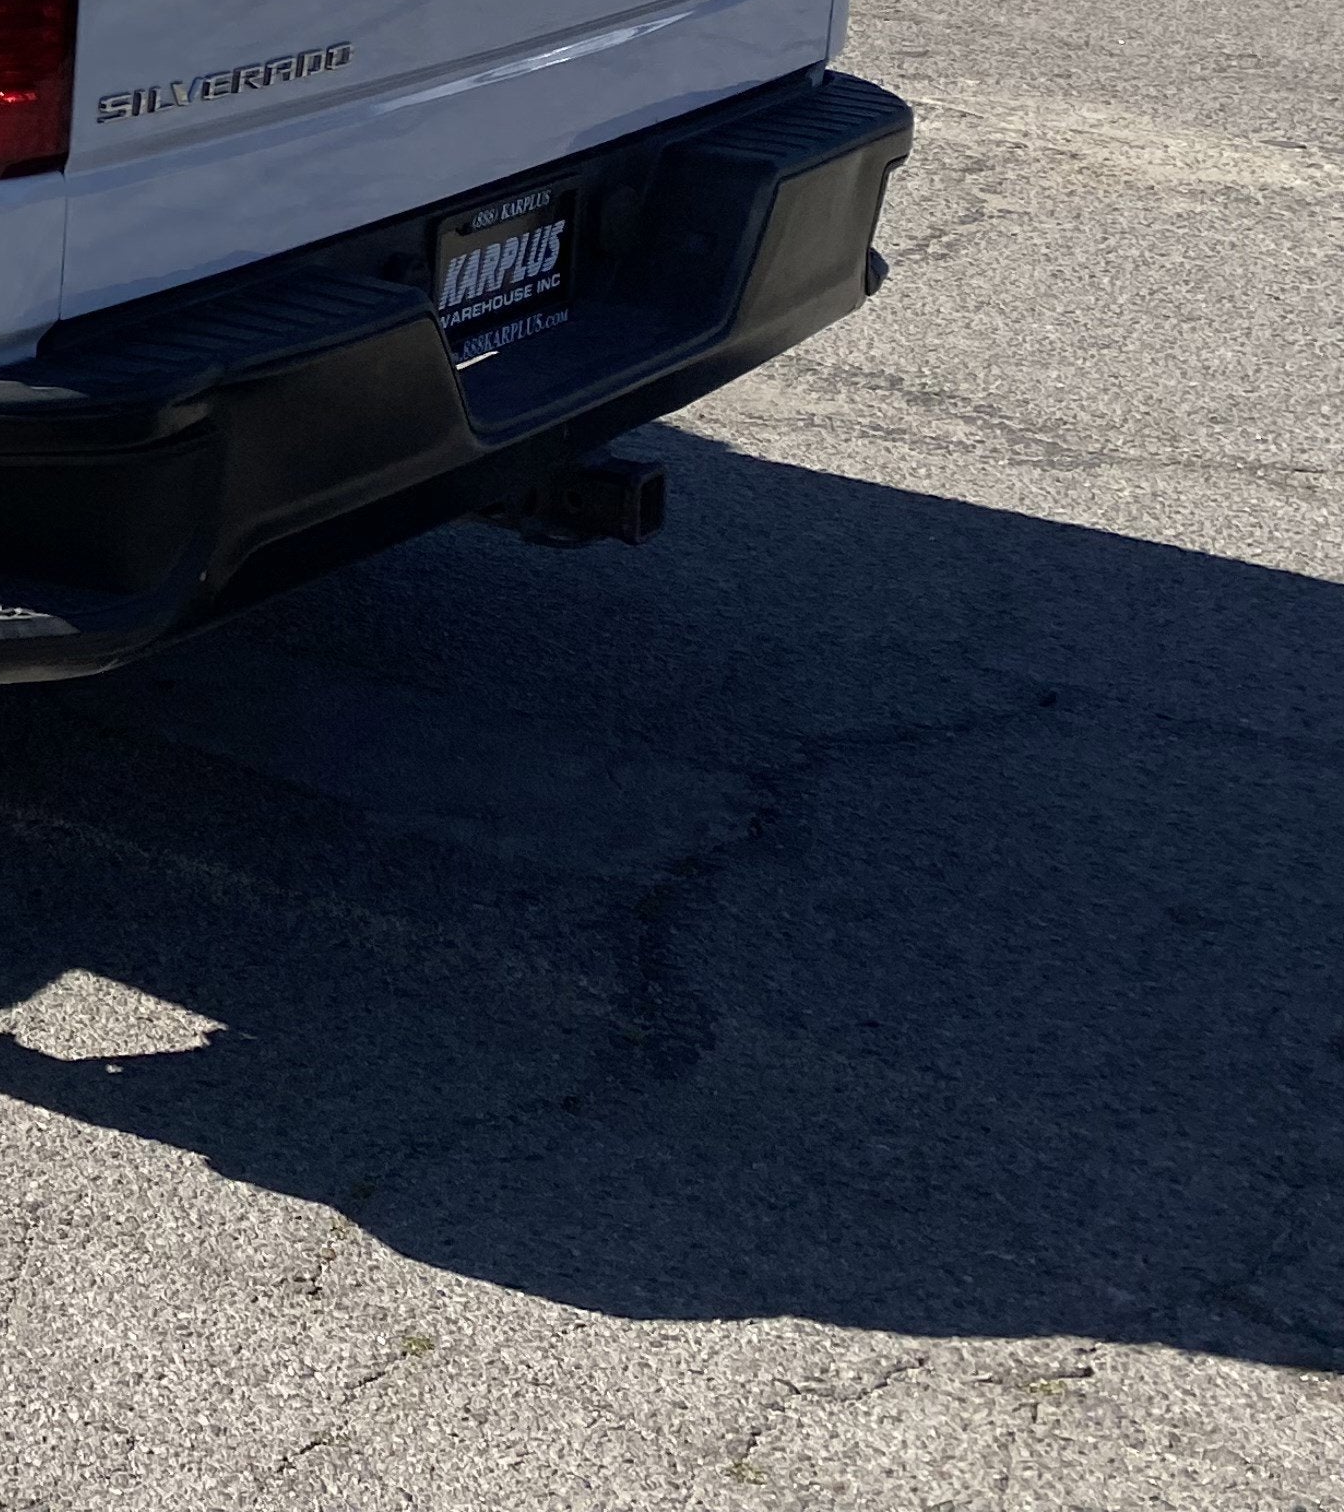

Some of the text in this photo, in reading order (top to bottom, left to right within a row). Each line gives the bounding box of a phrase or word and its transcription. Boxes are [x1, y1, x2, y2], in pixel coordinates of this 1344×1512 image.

[96, 40, 355, 124] SILVERADO
[500, 189, 552, 221] KARPLUS
[438, 219, 567, 310] KARPLUS
[439, 273, 561, 329] WAREHOUSE INC
